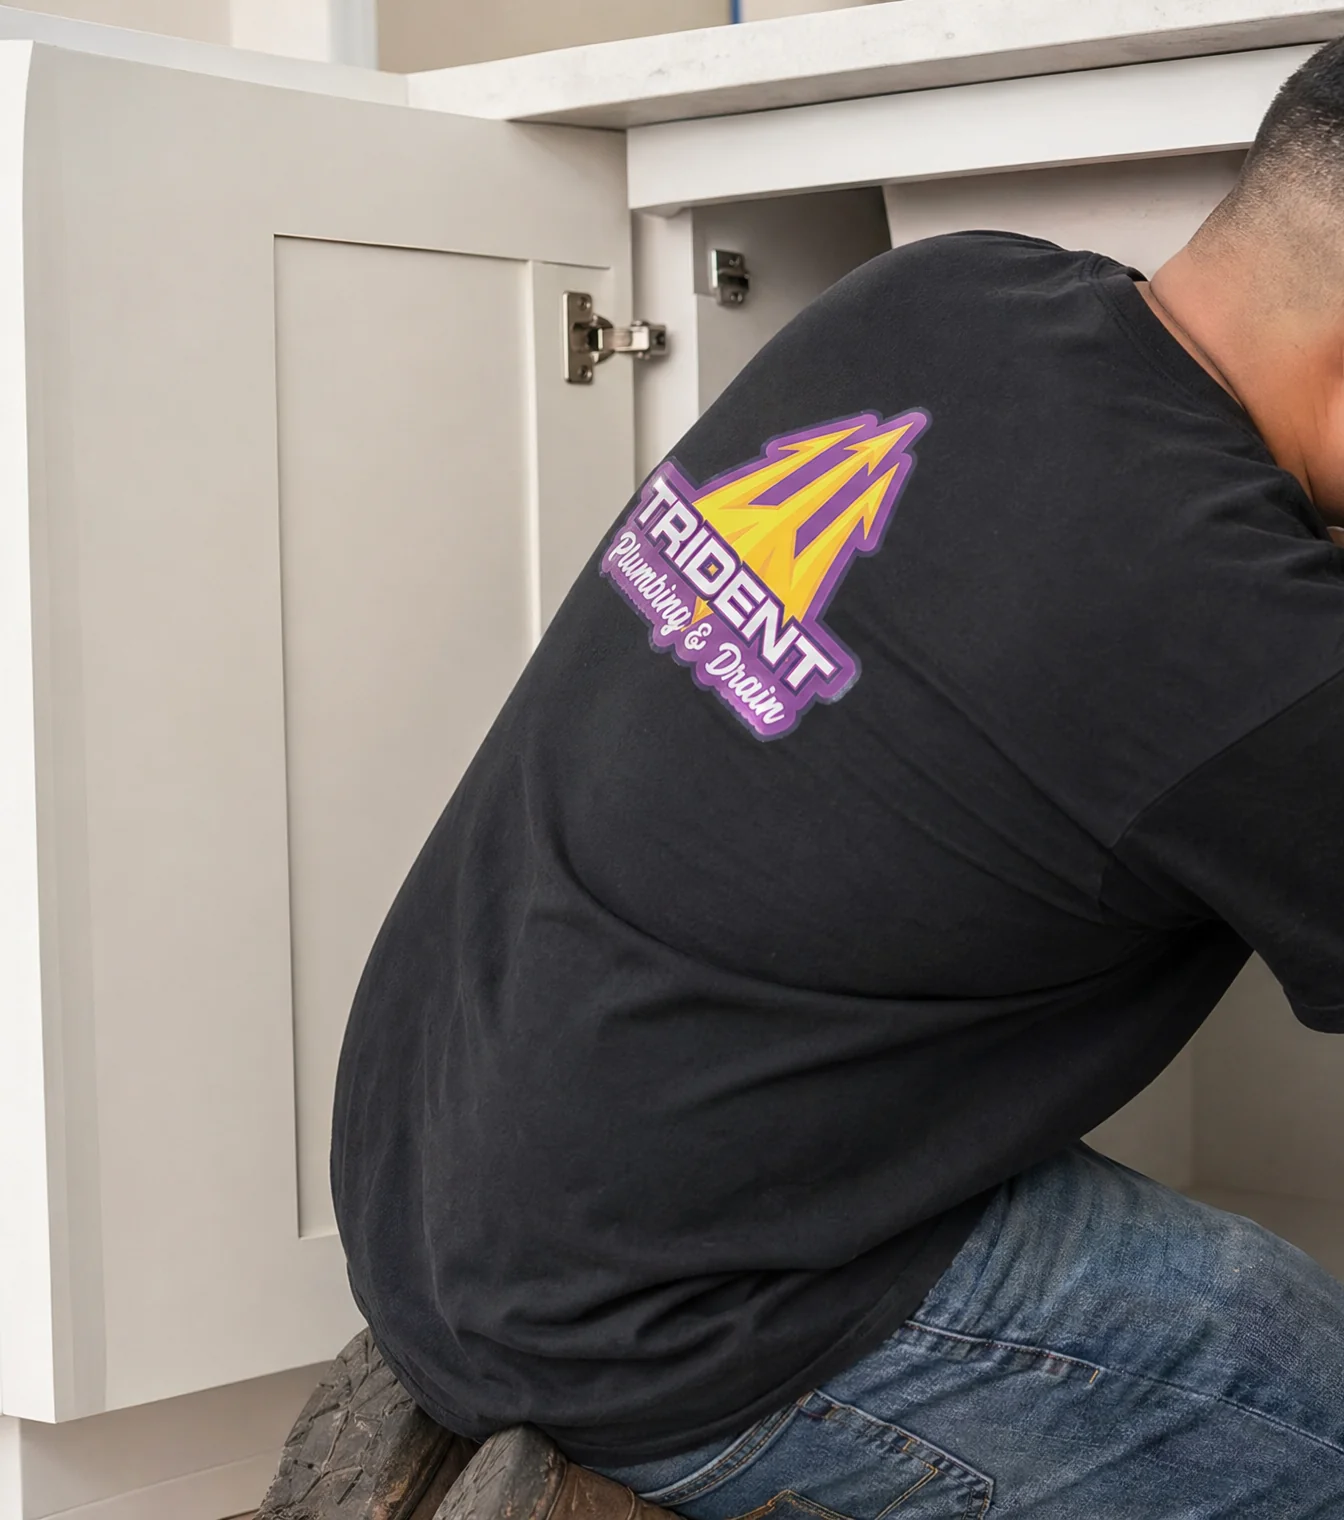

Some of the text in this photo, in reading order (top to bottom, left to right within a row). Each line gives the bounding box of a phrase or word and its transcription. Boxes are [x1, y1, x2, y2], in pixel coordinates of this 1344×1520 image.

[608, 531, 785, 725] Plumbing & Drain
[640, 477, 837, 689] TRIDENT
